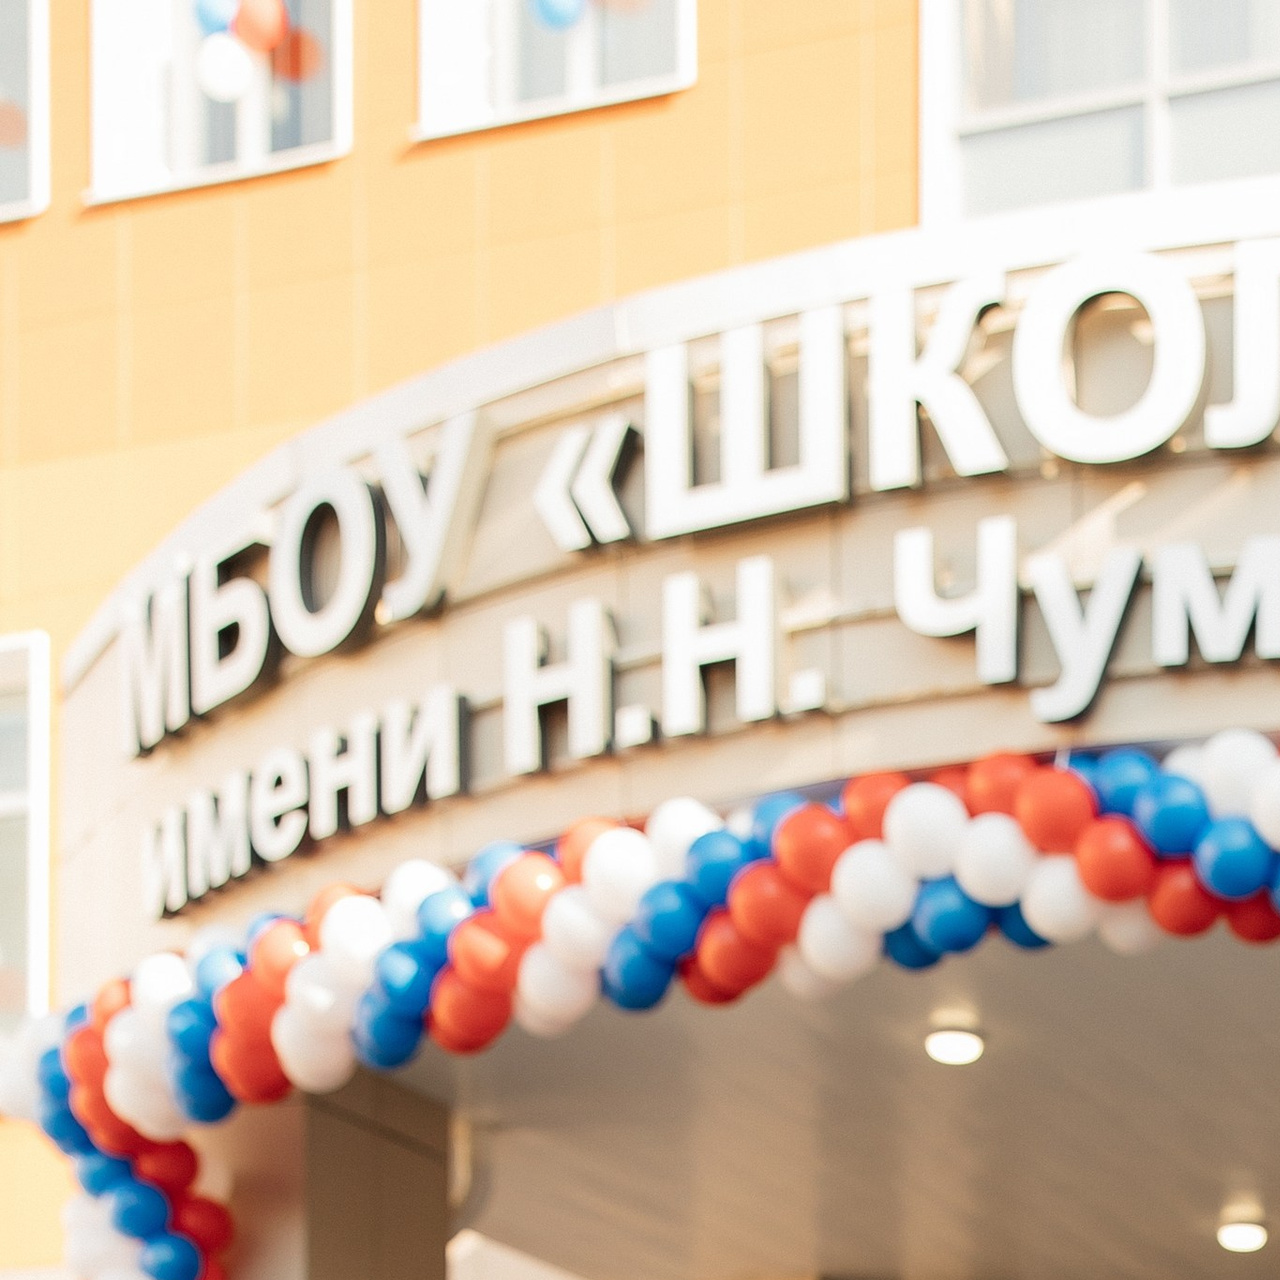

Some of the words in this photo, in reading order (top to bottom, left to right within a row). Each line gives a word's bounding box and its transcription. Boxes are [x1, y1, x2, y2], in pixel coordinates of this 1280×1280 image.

[118, 408, 482, 760] МБОУ
[144, 683, 464, 920] имени
[500, 554, 828, 778] Н.Н.
